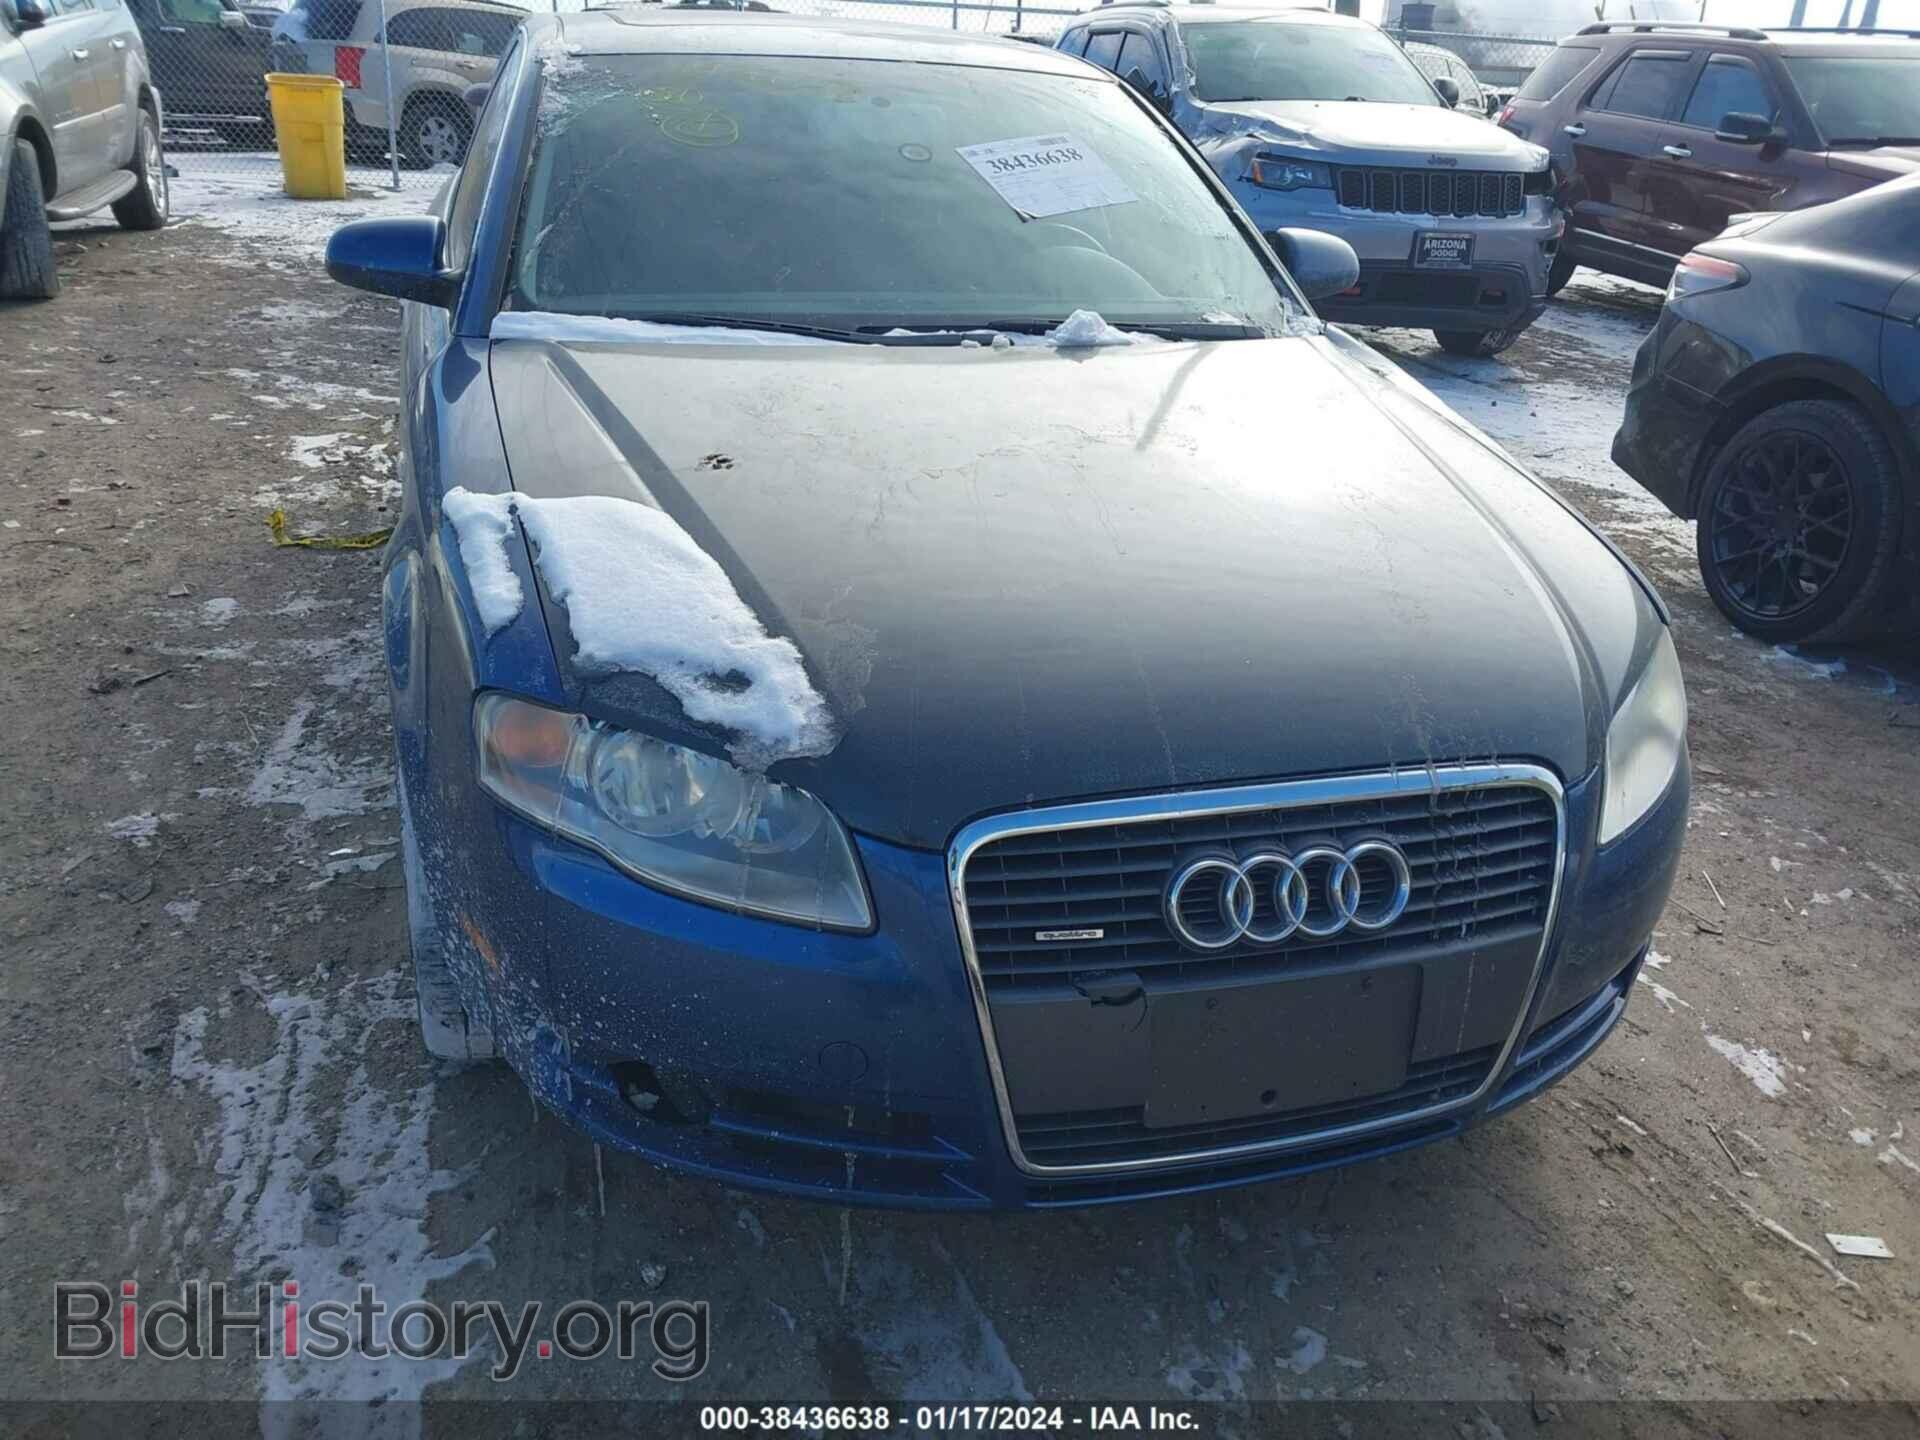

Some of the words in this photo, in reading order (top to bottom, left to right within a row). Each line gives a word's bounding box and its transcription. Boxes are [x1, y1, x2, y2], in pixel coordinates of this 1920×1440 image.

[985, 147, 1083, 174] 38436638
[1427, 154, 1458, 167] Jeep
[1424, 239, 1466, 250] ARIZONA
[1430, 249, 1458, 257] DODGE
[1043, 931, 1097, 940] quattro
